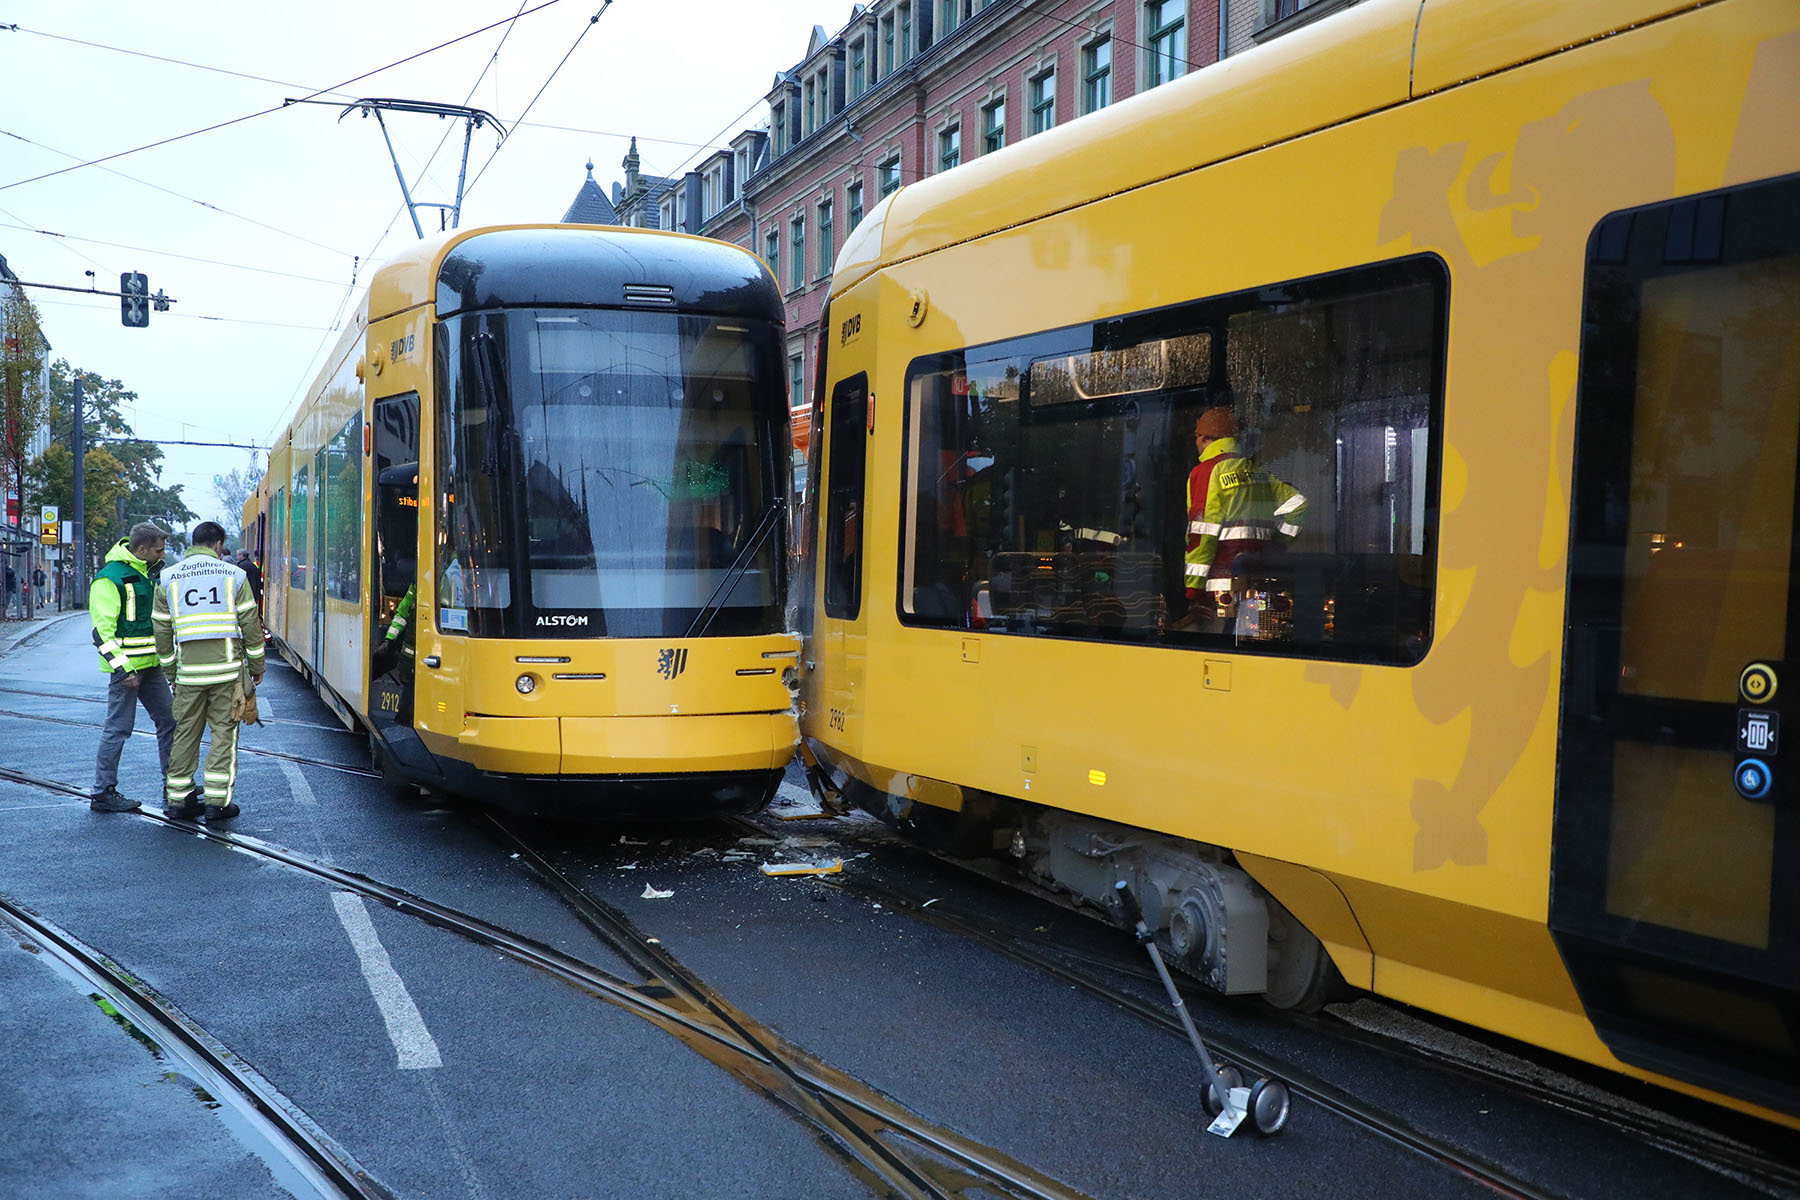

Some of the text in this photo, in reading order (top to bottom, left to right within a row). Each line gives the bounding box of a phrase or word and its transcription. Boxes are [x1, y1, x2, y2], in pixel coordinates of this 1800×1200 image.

[847, 313, 861, 337] DVB
[399, 334, 415, 355] DVB
[170, 568, 236, 580] Abschnittsleiter
[184, 586, 221, 607] C-1
[535, 614, 588, 627] ALSTOM
[381, 691, 400, 713] 2912
[829, 707, 845, 732] 2982
